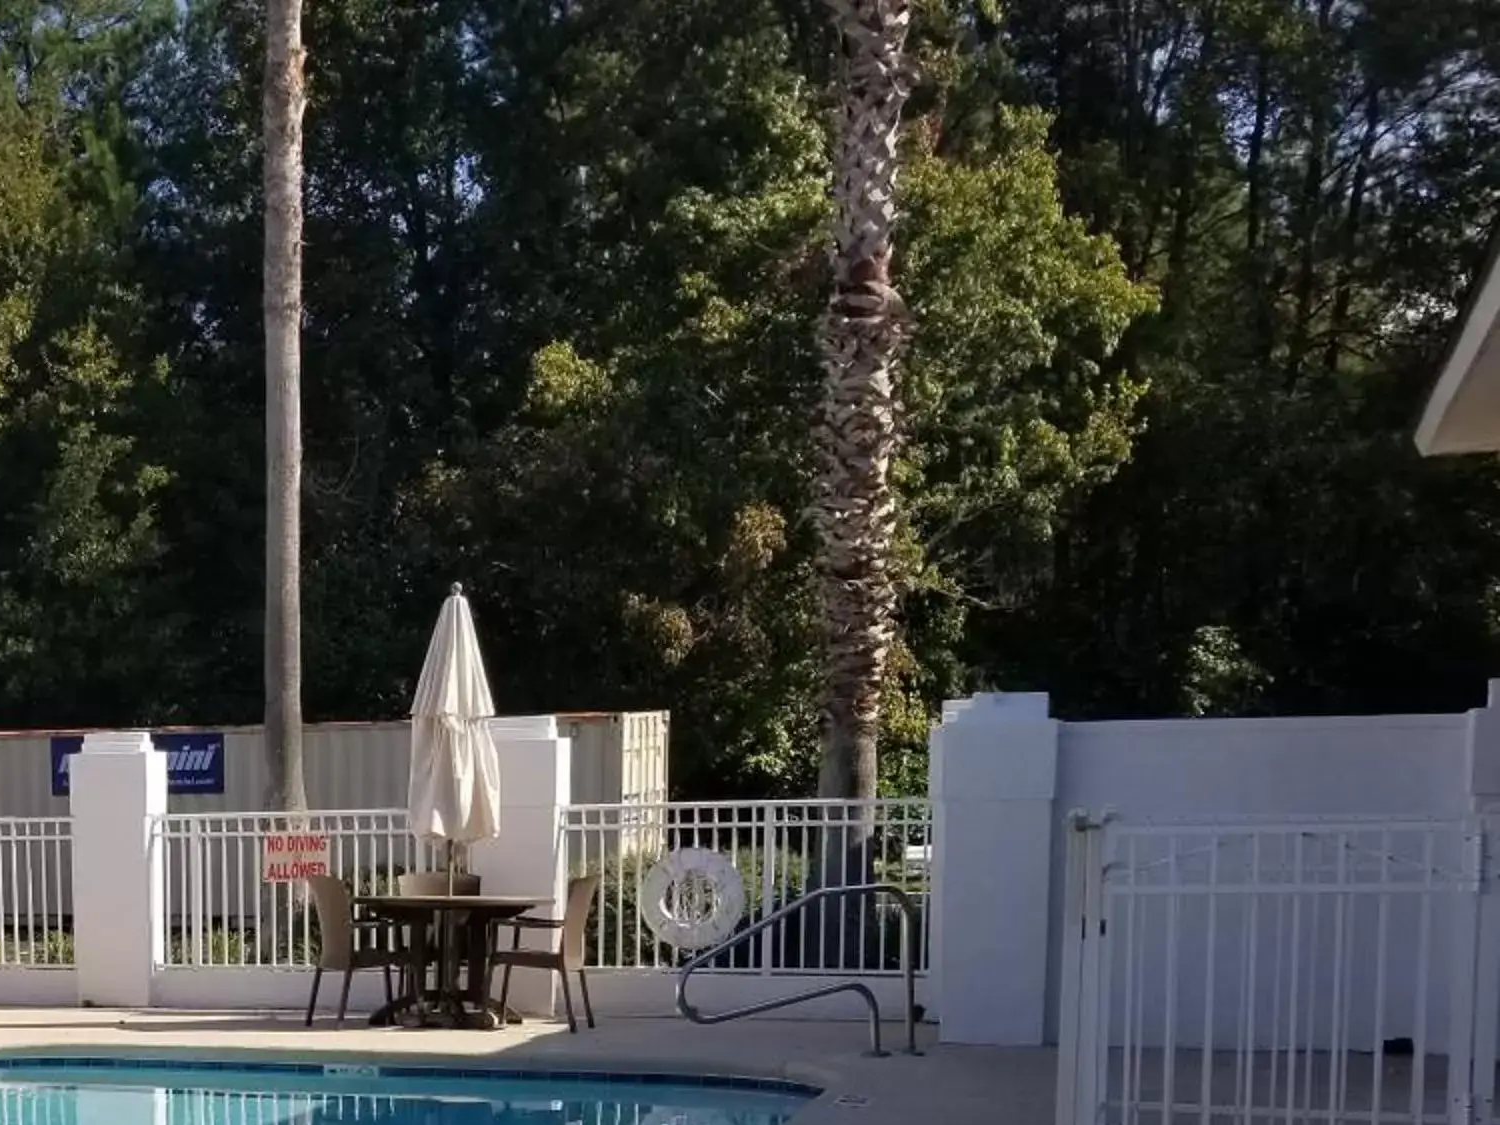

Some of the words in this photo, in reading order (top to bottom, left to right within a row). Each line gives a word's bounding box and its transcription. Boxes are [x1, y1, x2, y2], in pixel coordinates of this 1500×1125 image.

[267, 835, 284, 853] NO
[287, 834, 326, 852] DIVING
[267, 862, 327, 880] ALLOWED
